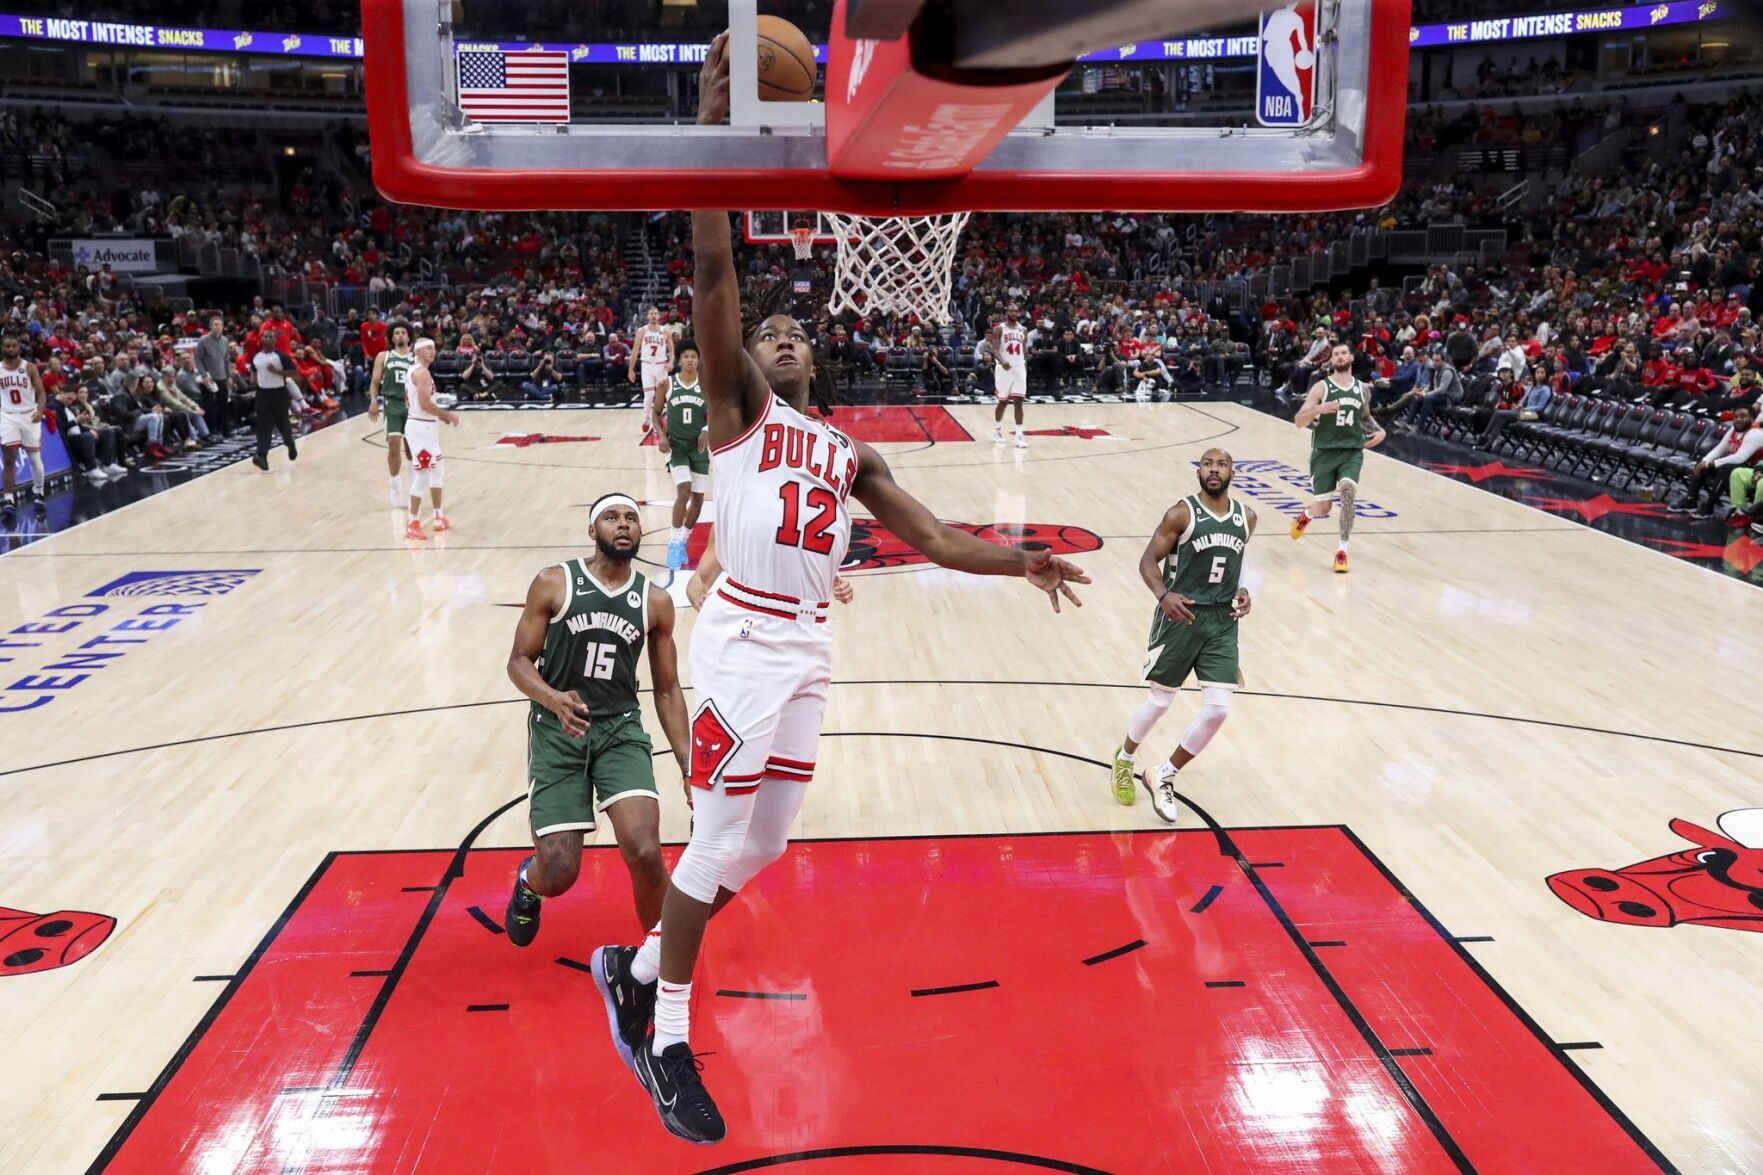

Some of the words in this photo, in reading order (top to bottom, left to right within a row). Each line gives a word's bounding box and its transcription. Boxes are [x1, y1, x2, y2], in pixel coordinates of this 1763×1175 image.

[20, 18, 43, 35] THE
[46, 18, 89, 41] MOST
[92, 22, 155, 46] INTENSE
[157, 29, 204, 46] SNACKS
[1447, 25, 1467, 41] THE
[1470, 20, 1510, 41] MOST
[1512, 14, 1574, 37] INTENSE
[1576, 11, 1622, 30] SNACKS
[329, 38, 351, 54] THE
[616, 46, 636, 60] THE
[639, 44, 676, 61] MOST
[1163, 42, 1183, 56] THE
[1186, 38, 1224, 57] MOST
[1265, 96, 1292, 117] NBA
[93, 248, 151, 262] Advocate
[650, 346, 657, 357] 7
[1007, 343, 1020, 355] 44
[10, 389, 21, 405] 0
[682, 408, 692, 424] 0
[1336, 410, 1354, 426] 54
[758, 423, 857, 505] BULLS
[776, 480, 837, 556] 12
[1208, 556, 1226, 583] 5
[577, 577, 584, 585] 6
[566, 612, 640, 645] MILWAUKEE
[583, 641, 617, 680] 15
